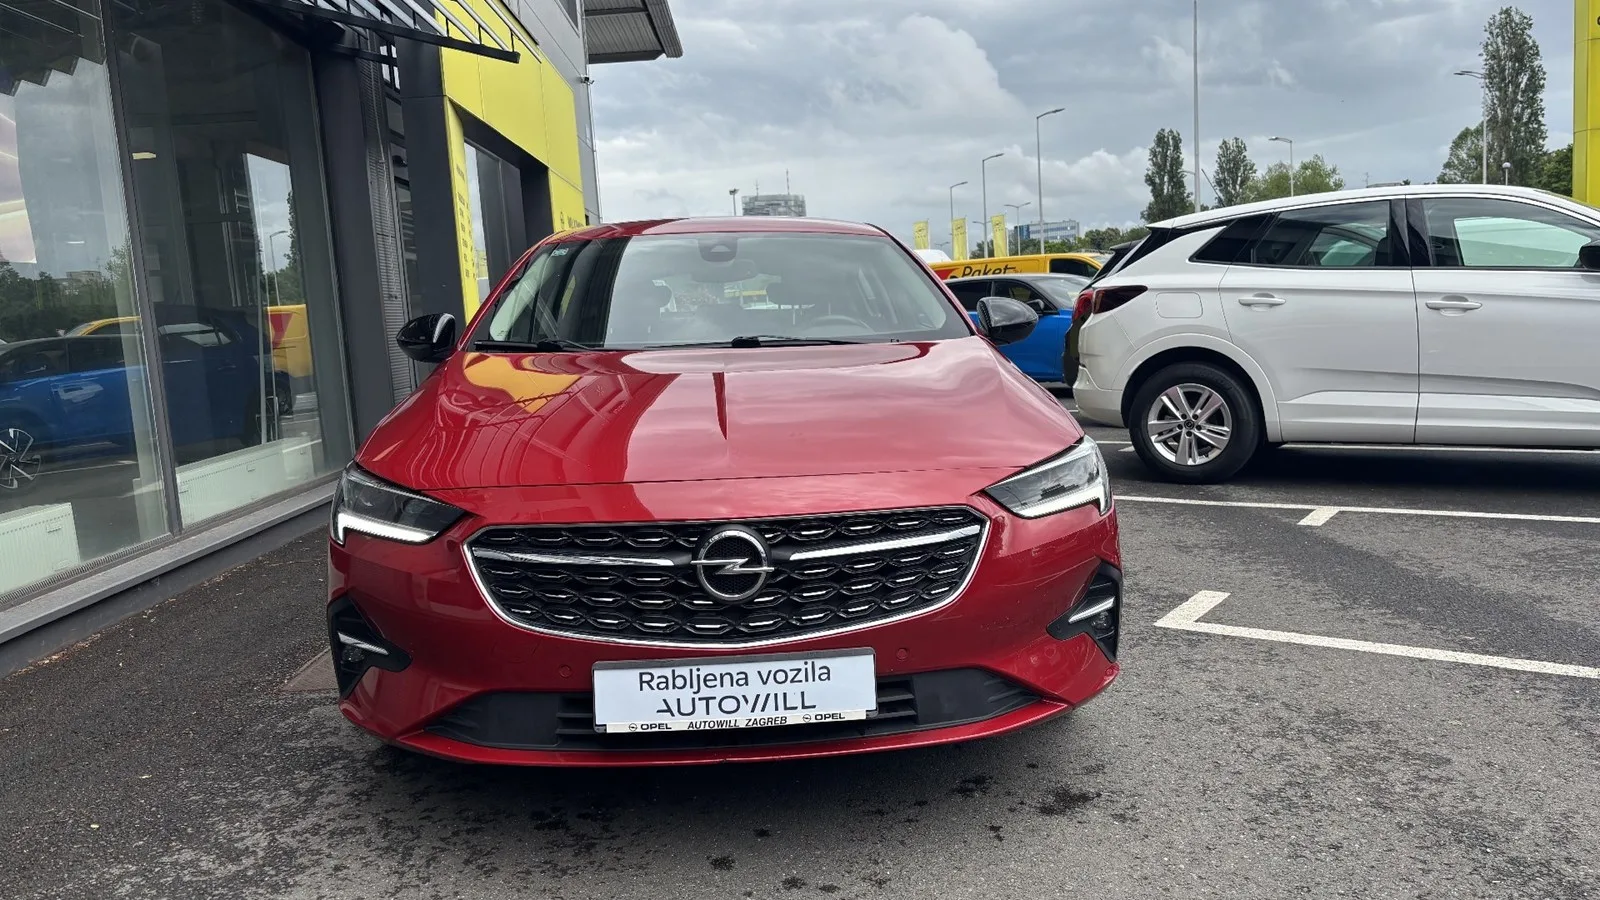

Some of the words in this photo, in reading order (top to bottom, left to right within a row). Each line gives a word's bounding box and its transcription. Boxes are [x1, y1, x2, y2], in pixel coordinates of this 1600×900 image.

[962, 264, 1016, 277] Paket
[639, 668, 749, 694] Rabljena
[757, 661, 831, 685] vozila
[640, 723, 672, 731] OPEL
[687, 719, 740, 730] AUTOWILL
[745, 716, 788, 727] ZAGREB
[814, 713, 846, 721] OPEL
